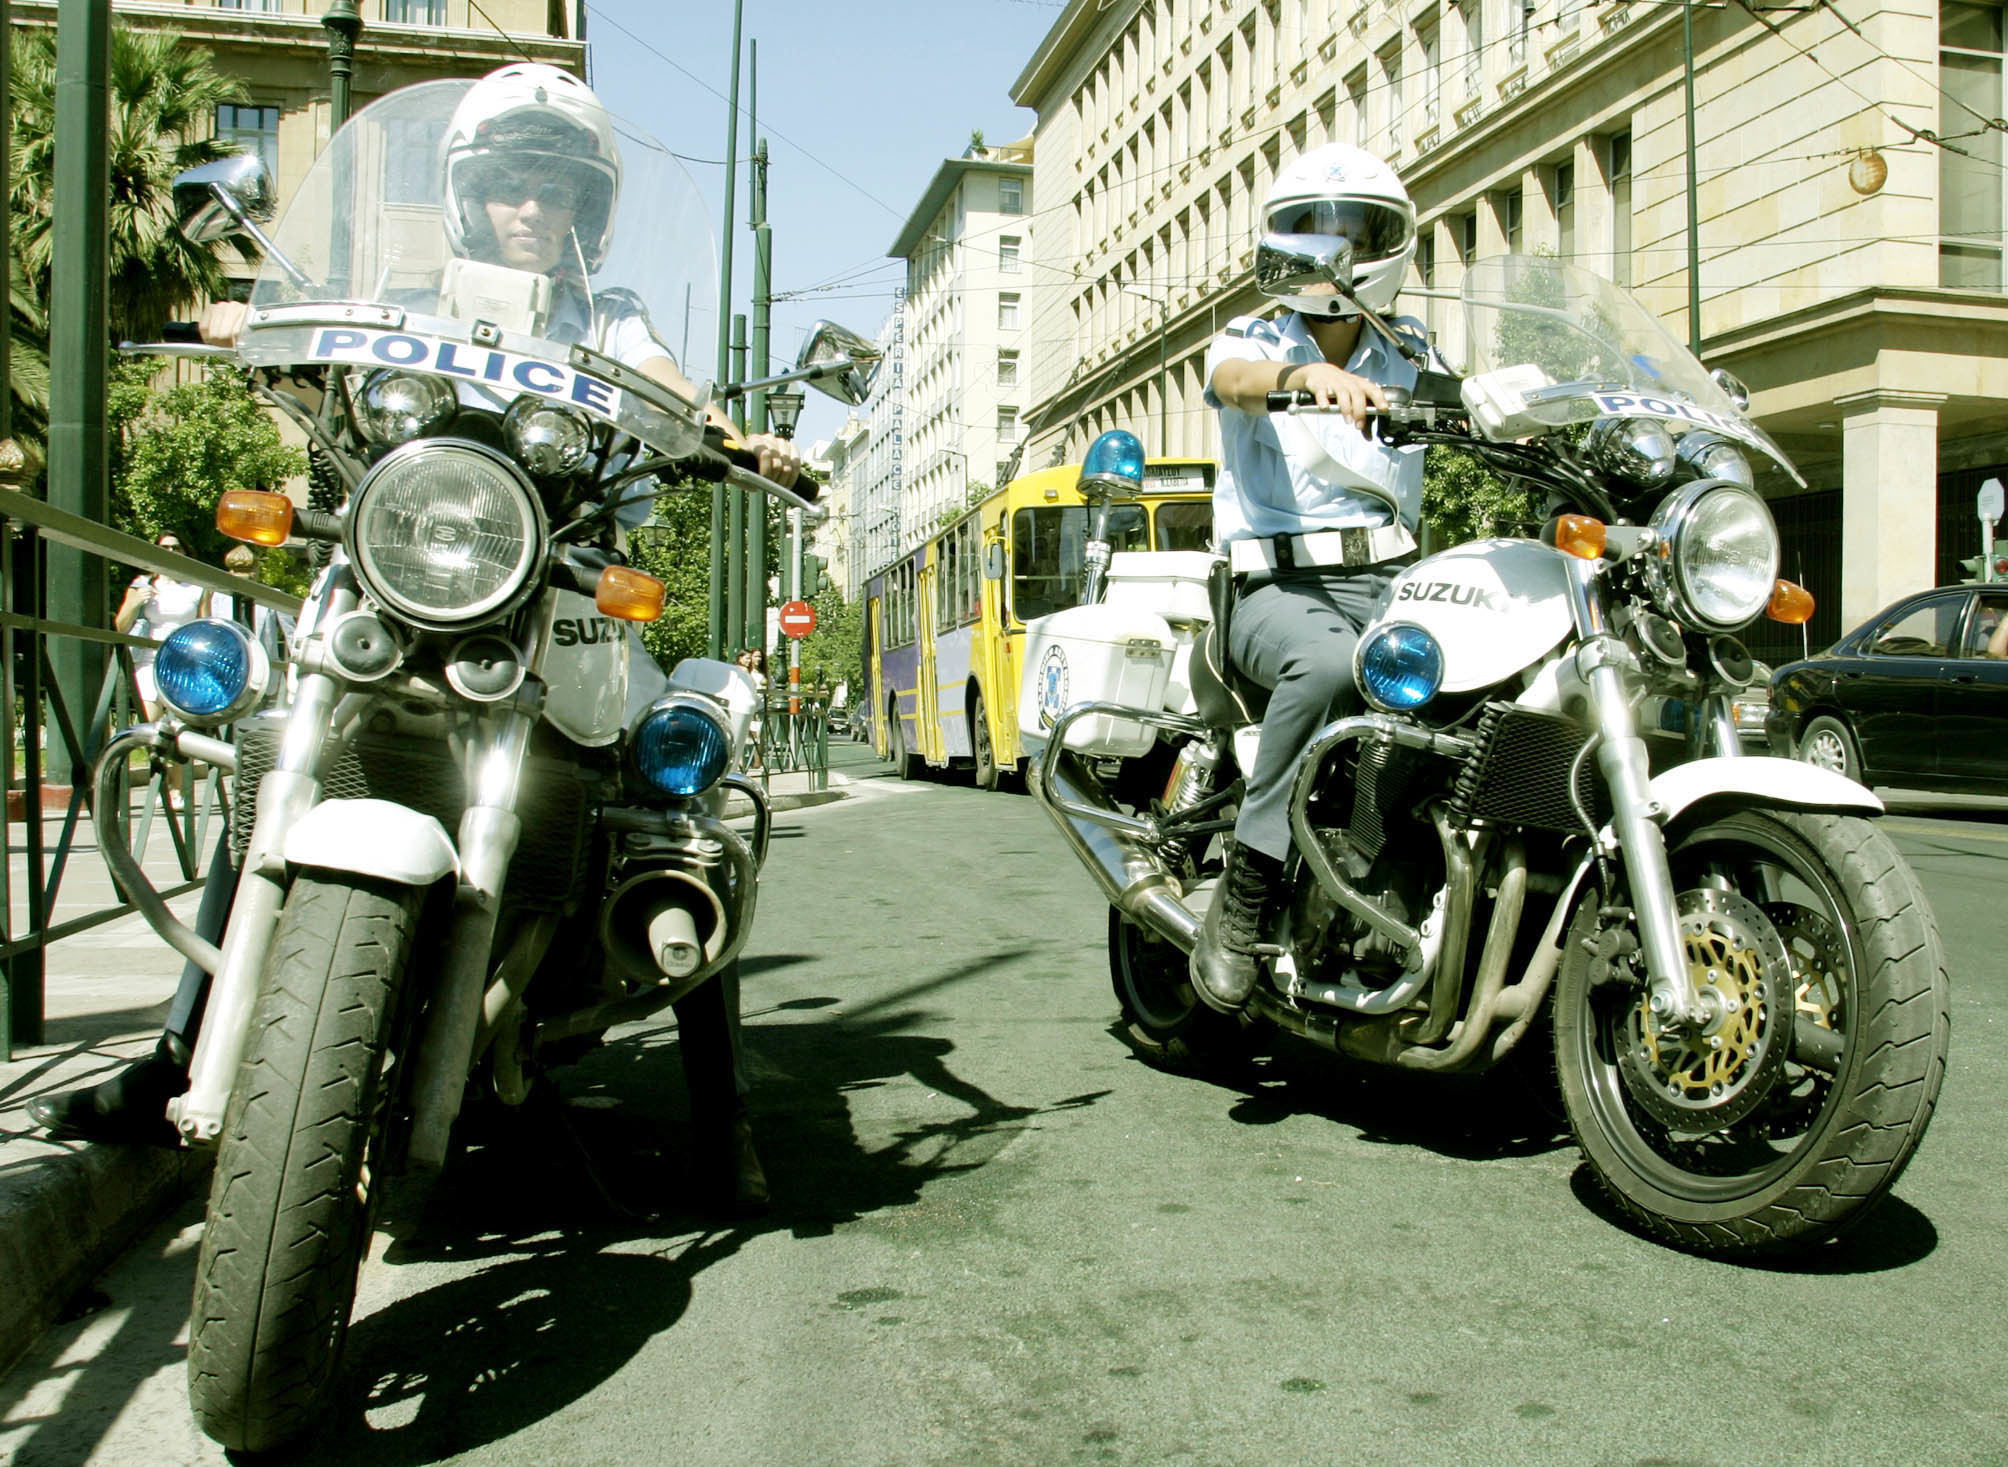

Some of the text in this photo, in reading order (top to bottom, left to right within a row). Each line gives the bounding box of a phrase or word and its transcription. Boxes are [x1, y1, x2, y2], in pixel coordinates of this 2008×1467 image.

[315, 329, 614, 416] POLICE
[894, 287, 904, 389] ESPERIA
[892, 404, 902, 491] PALACE
[1601, 395, 1757, 446] POLIC
[1398, 582, 1506, 611] SUZUK
